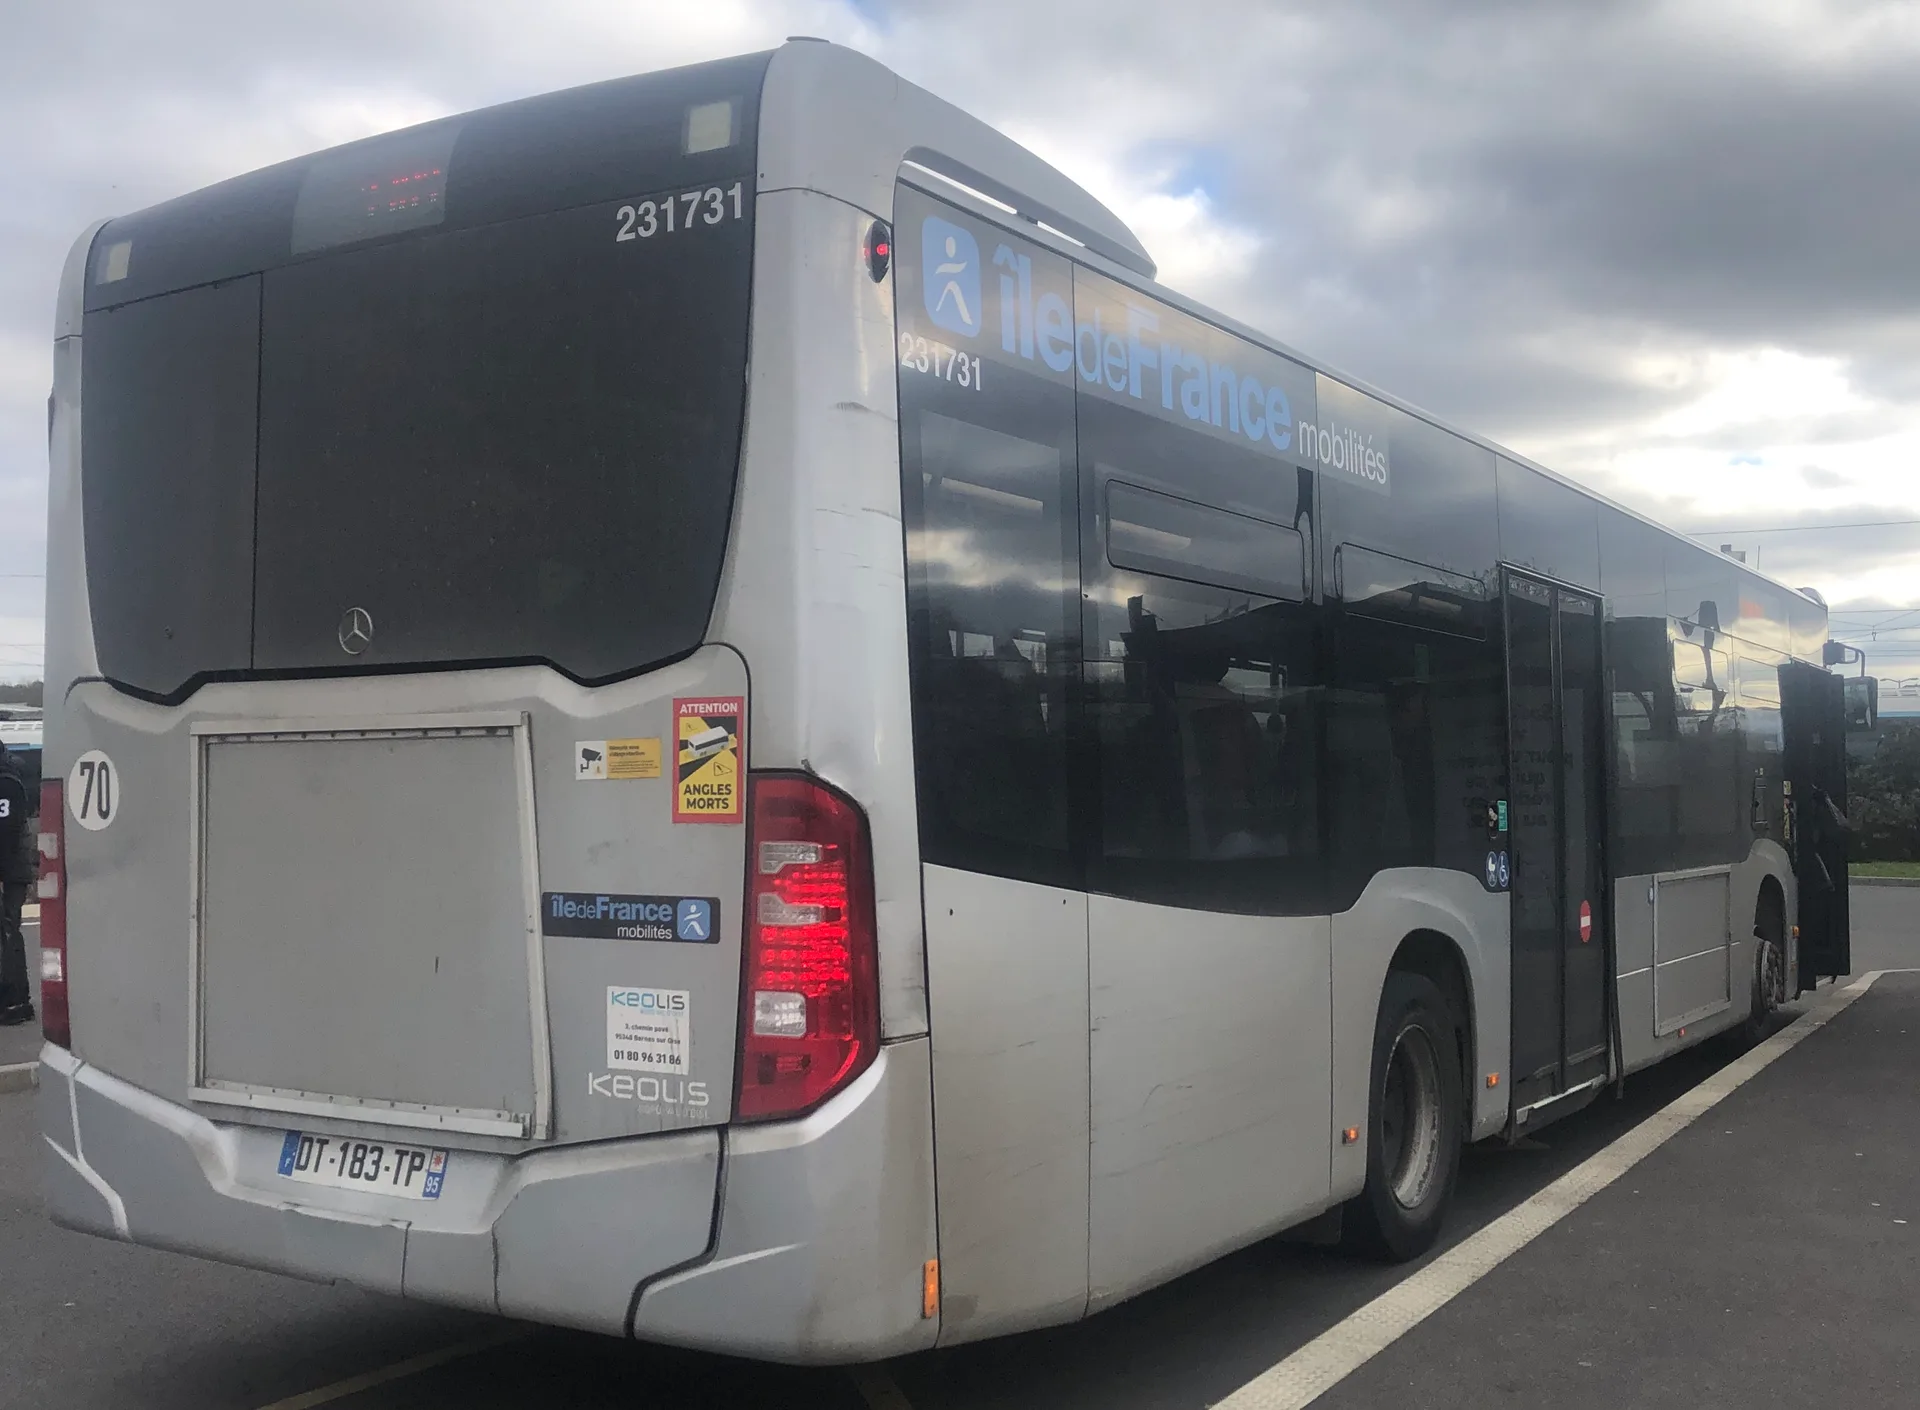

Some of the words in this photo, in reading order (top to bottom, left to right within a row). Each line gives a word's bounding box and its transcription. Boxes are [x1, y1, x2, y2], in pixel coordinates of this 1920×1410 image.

[616, 182, 742, 242] 231731
[901, 332, 981, 391] 231731
[1298, 420, 1387, 485] mobilités
[680, 703, 738, 714] ATTENTION
[79, 761, 110, 820] 70
[683, 784, 732, 796] ANGLES
[686, 798, 729, 810] MORTS
[617, 924, 672, 940] mobilités
[614, 1049, 624, 1060] 01
[627, 1051, 639, 1062] 80
[641, 1052, 653, 1063] 96
[656, 1053, 667, 1064] 31
[669, 1054, 681, 1065] 86
[294, 1136, 426, 1187] DT-183-TP
[425, 1176, 439, 1193] 95
